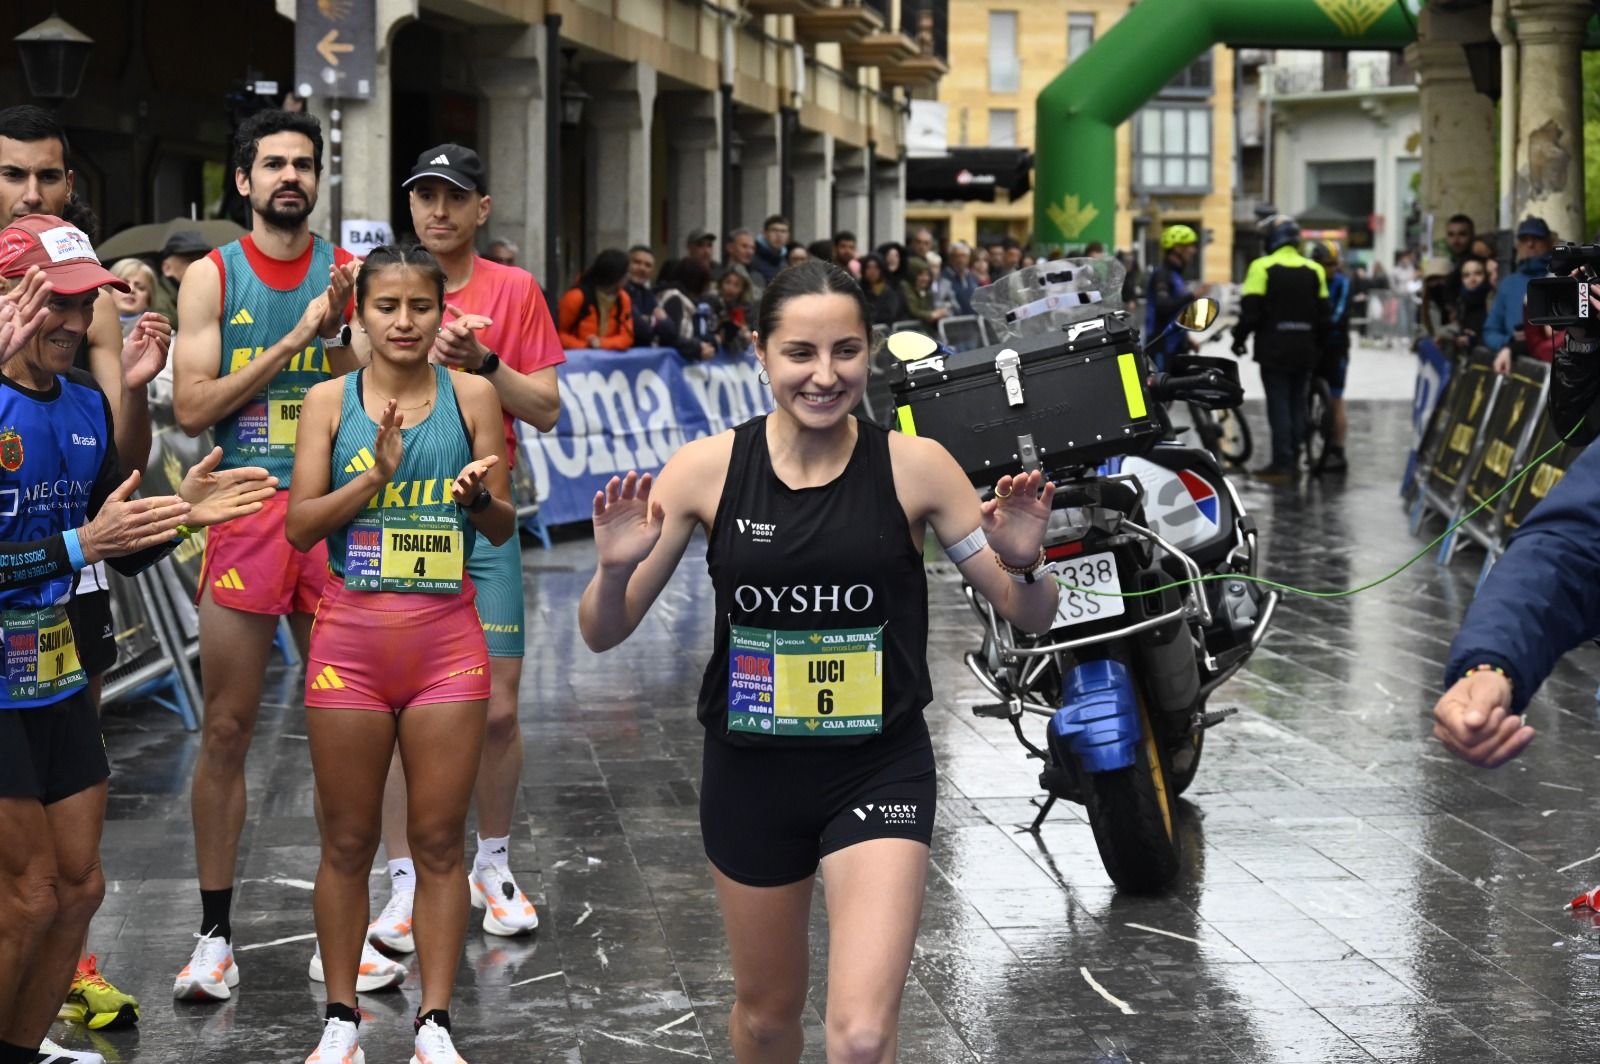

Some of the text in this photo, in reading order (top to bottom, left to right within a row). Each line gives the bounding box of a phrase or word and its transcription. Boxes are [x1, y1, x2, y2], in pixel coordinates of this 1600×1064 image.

[1580, 284, 1588, 316] cyltv
[751, 522, 776, 532] VICKY
[392, 534, 452, 553] TISALEMA
[24, 548, 46, 564] CROSS
[368, 558, 379, 567] 26
[414, 556, 426, 576] 4
[735, 584, 874, 612] OYSHO
[732, 636, 770, 648] Telenauto
[822, 636, 844, 644] CAJA
[846, 634, 876, 642] RURAL
[8, 656, 37, 664] ASTORGA
[56, 652, 64, 676] 10
[734, 655, 770, 676] 10K
[26, 664, 35, 672] 26
[808, 660, 844, 683] LUCI
[732, 672, 761, 681] CIUDAD
[732, 680, 773, 692] ASTORGA
[758, 692, 770, 702] 26
[818, 688, 834, 715] 6
[748, 704, 772, 714] CAJÓN A
[847, 720, 878, 728] RURAL
[879, 804, 917, 812] VICKY
